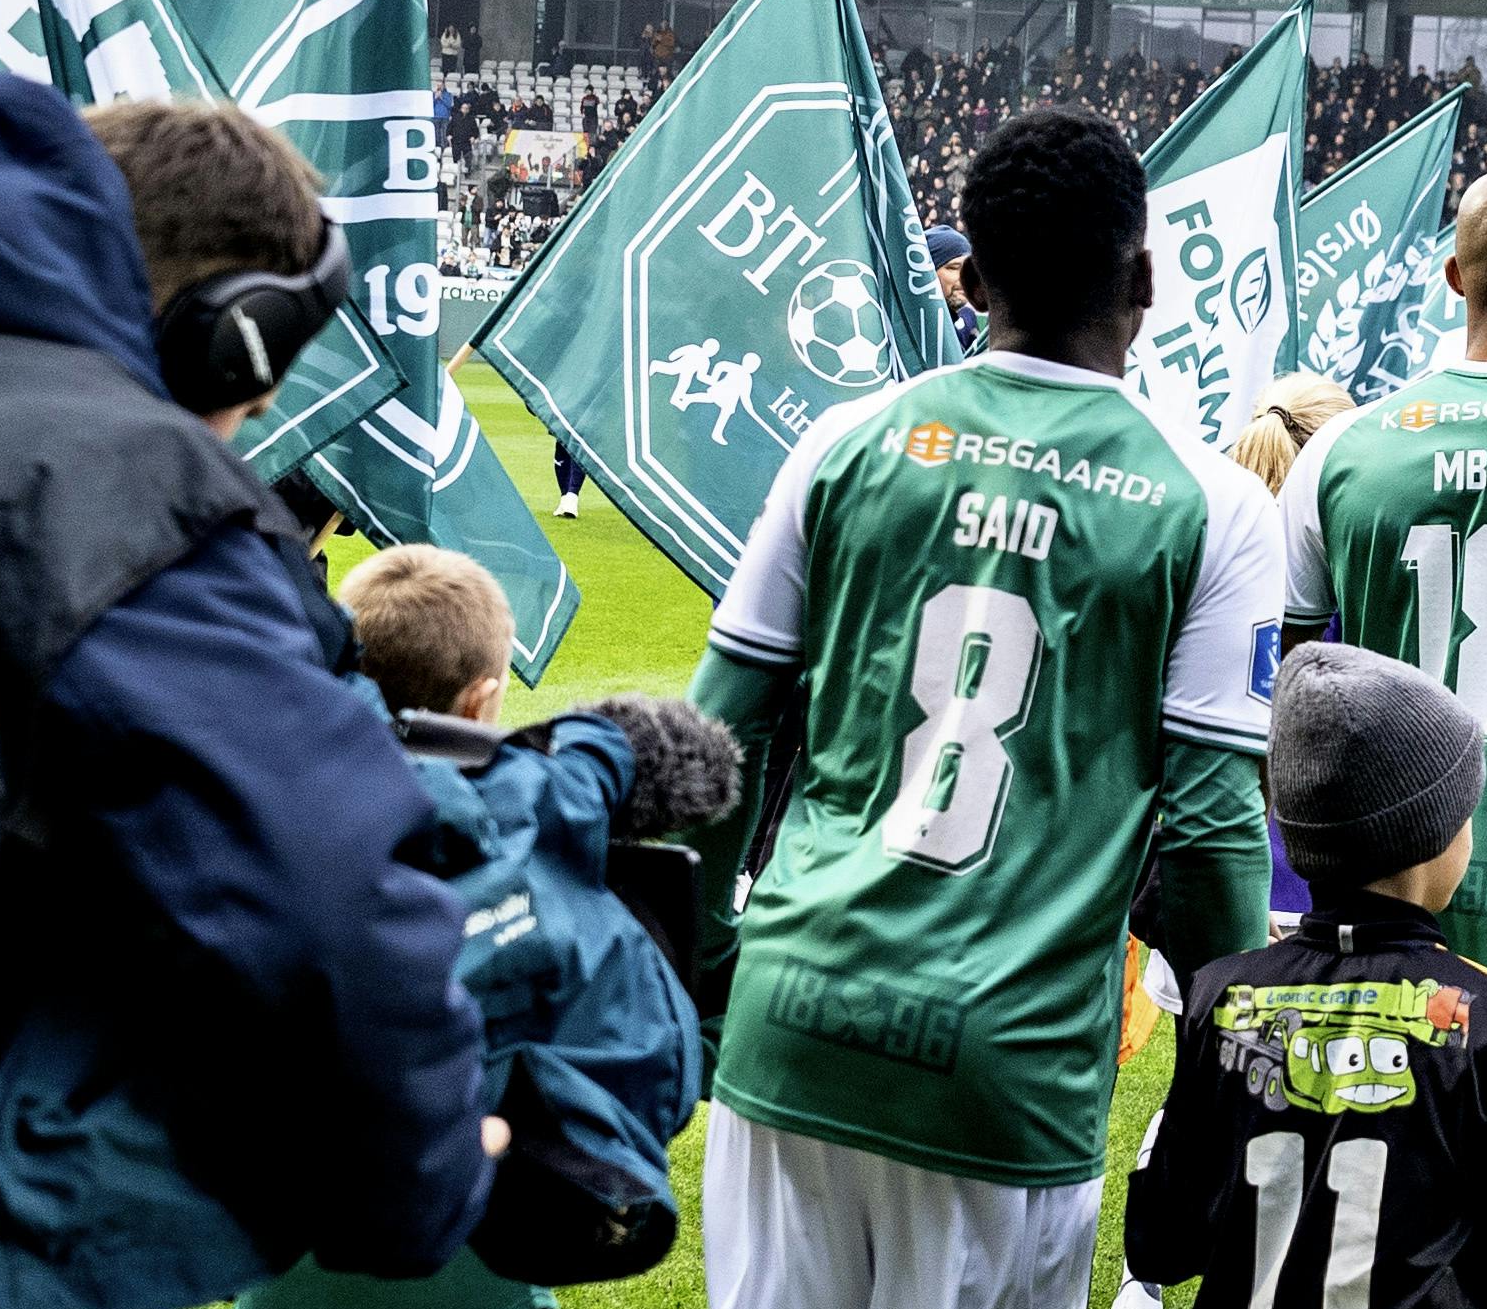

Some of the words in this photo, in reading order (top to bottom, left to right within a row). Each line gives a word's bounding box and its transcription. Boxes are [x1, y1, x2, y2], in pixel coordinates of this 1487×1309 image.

[1152, 321, 1201, 375] IF
[953, 492, 1059, 562] SAID
[882, 583, 1045, 877] 8
[1319, 987, 1378, 1005] crane
